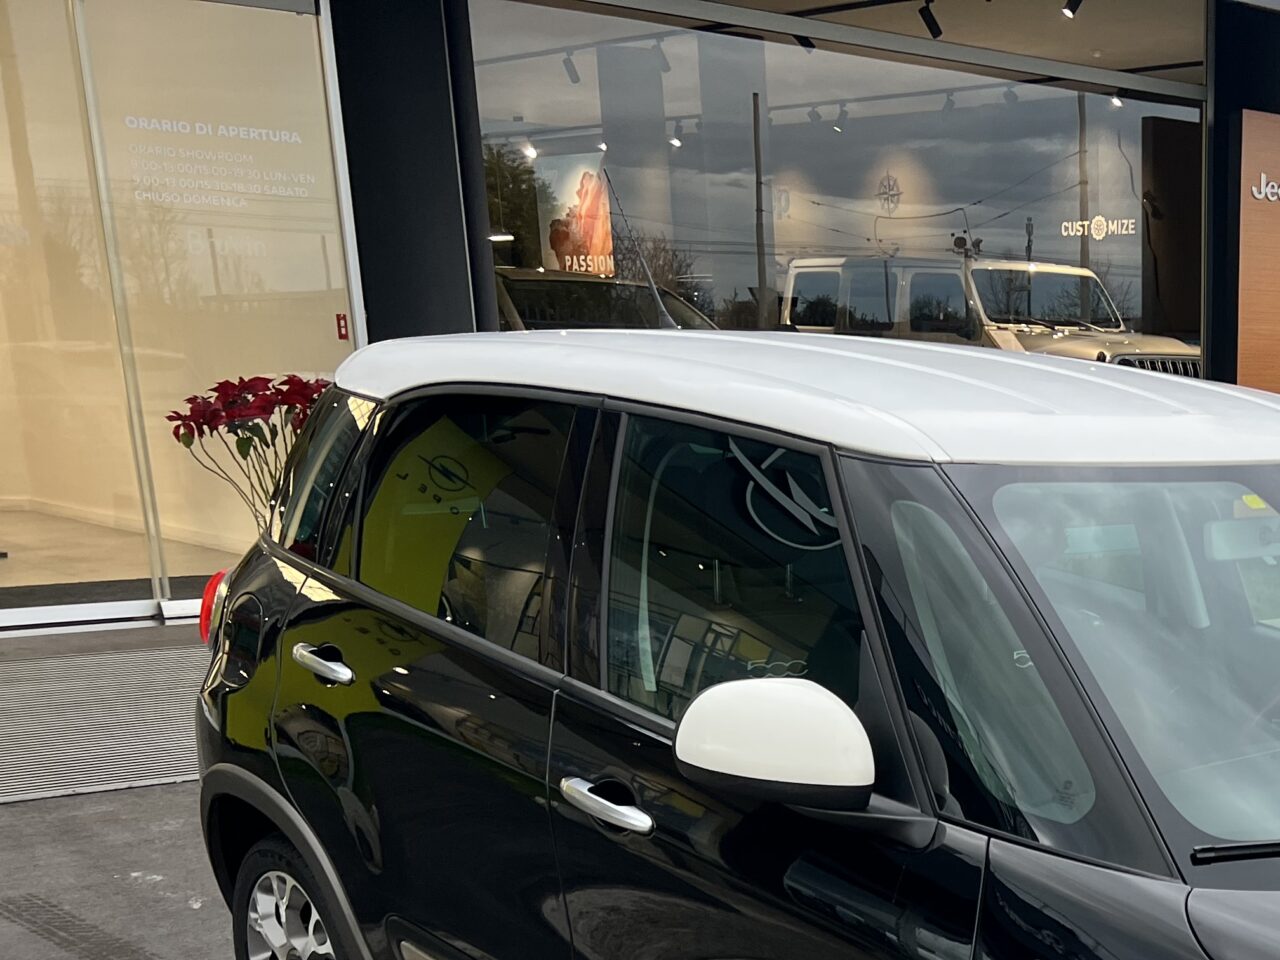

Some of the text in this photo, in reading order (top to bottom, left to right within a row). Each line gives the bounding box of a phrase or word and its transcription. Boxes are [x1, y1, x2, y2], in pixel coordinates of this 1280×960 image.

[124, 115, 302, 144] ORARIO DI APERTURA
[129, 143, 254, 164] ORARIO SHOWROOM
[135, 190, 180, 203] CHIUSO
[264, 185, 308, 198] SABATO
[565, 254, 615, 272] PASSION
